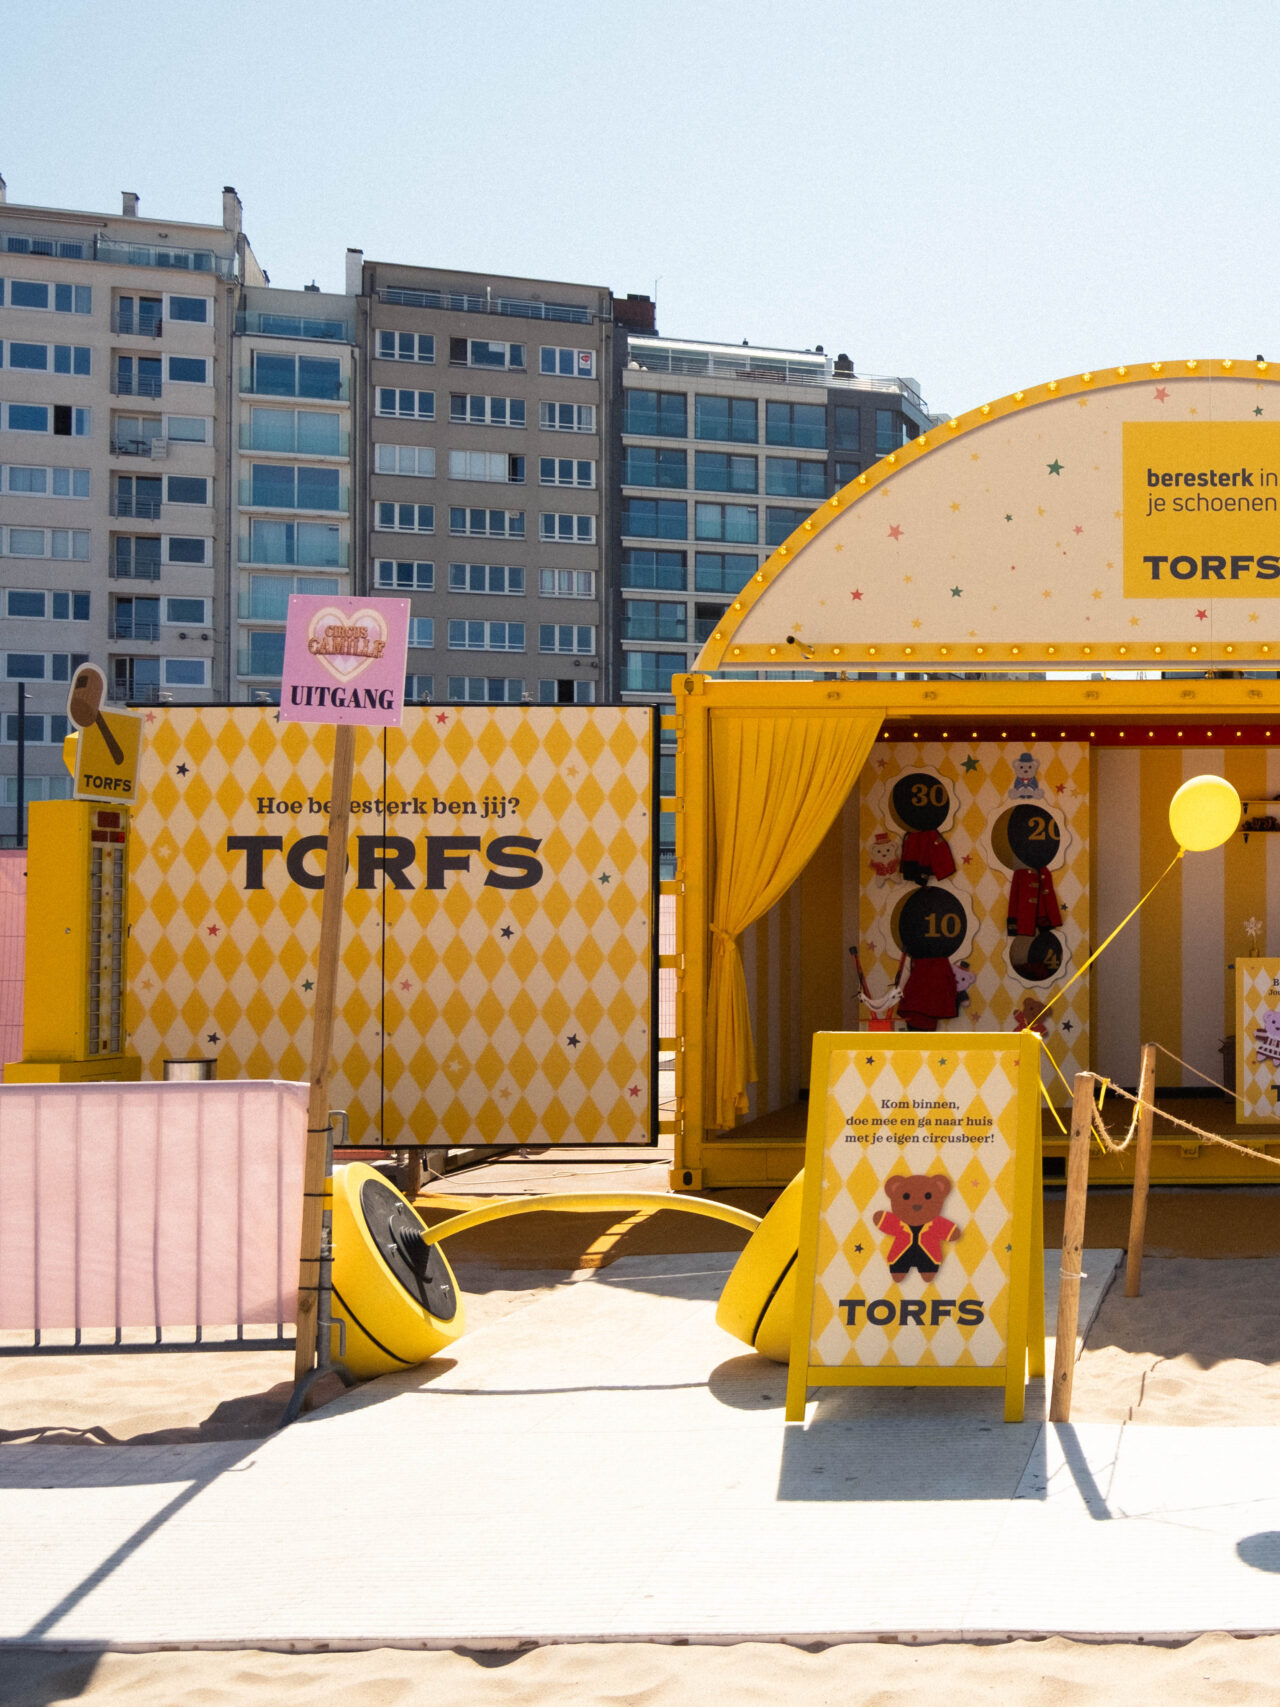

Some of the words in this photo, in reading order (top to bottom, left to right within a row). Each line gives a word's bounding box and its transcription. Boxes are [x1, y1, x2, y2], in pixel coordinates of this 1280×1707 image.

[1147, 468, 1254, 487] beresterk
[1259, 468, 1278, 487] in
[1146, 493, 1166, 516] je
[1172, 493, 1277, 512] schoenen
[324, 625, 368, 639] CIRCUS
[307, 637, 386, 659] CAMILLE
[290, 685, 394, 710] UITGANG
[84, 774, 131, 792] TORFS
[911, 783, 948, 807] 30
[257, 797, 302, 814] Hoe
[309, 797, 427, 815] beesterk
[433, 797, 477, 815] ben
[480, 796, 520, 819] jij?
[227, 834, 543, 890] TORFS
[924, 913, 961, 938] 10
[881, 1099, 909, 1109] Kom
[912, 1099, 960, 1110] binnen,
[846, 1116, 869, 1126] doe
[871, 1118, 898, 1126] mee
[900, 1118, 915, 1126] en
[917, 1117, 932, 1128] ga
[934, 1118, 964, 1126] naar
[966, 1116, 993, 1126] huis
[845, 1134, 870, 1143] met
[871, 1133, 884, 1145] je
[886, 1133, 920, 1145] eigen
[922, 1133, 995, 1143] circusbeer!
[838, 1299, 985, 1326] TORFS
